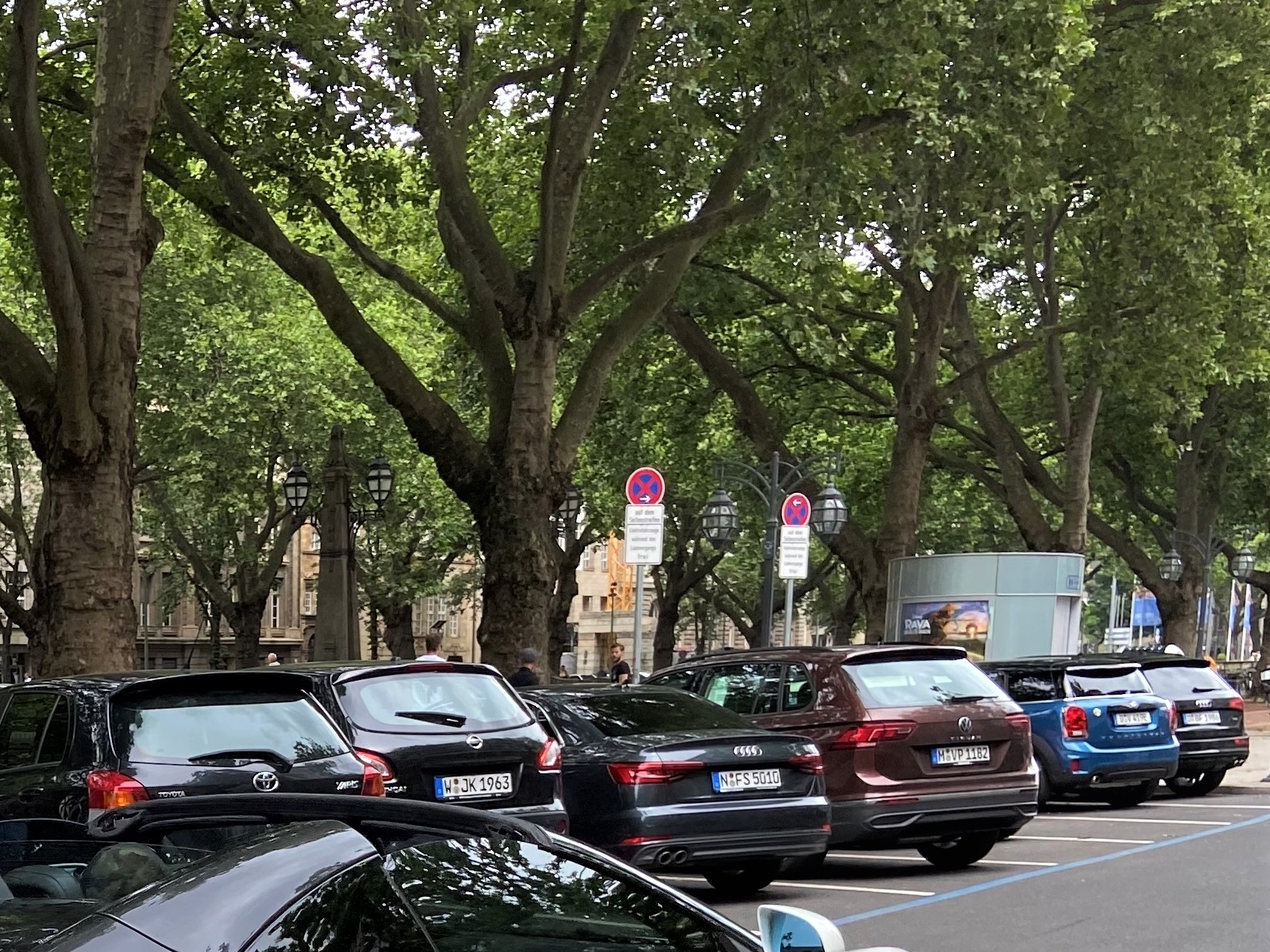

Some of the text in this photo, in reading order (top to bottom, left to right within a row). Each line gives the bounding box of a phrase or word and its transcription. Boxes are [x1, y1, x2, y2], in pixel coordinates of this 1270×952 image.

[904, 619, 930, 630] RAYA
[938, 747, 988, 762] M VP 1182
[444, 776, 509, 793] W JK 1963
[720, 771, 779, 787] N FS 5010
[158, 790, 186, 798] TOYOTA
